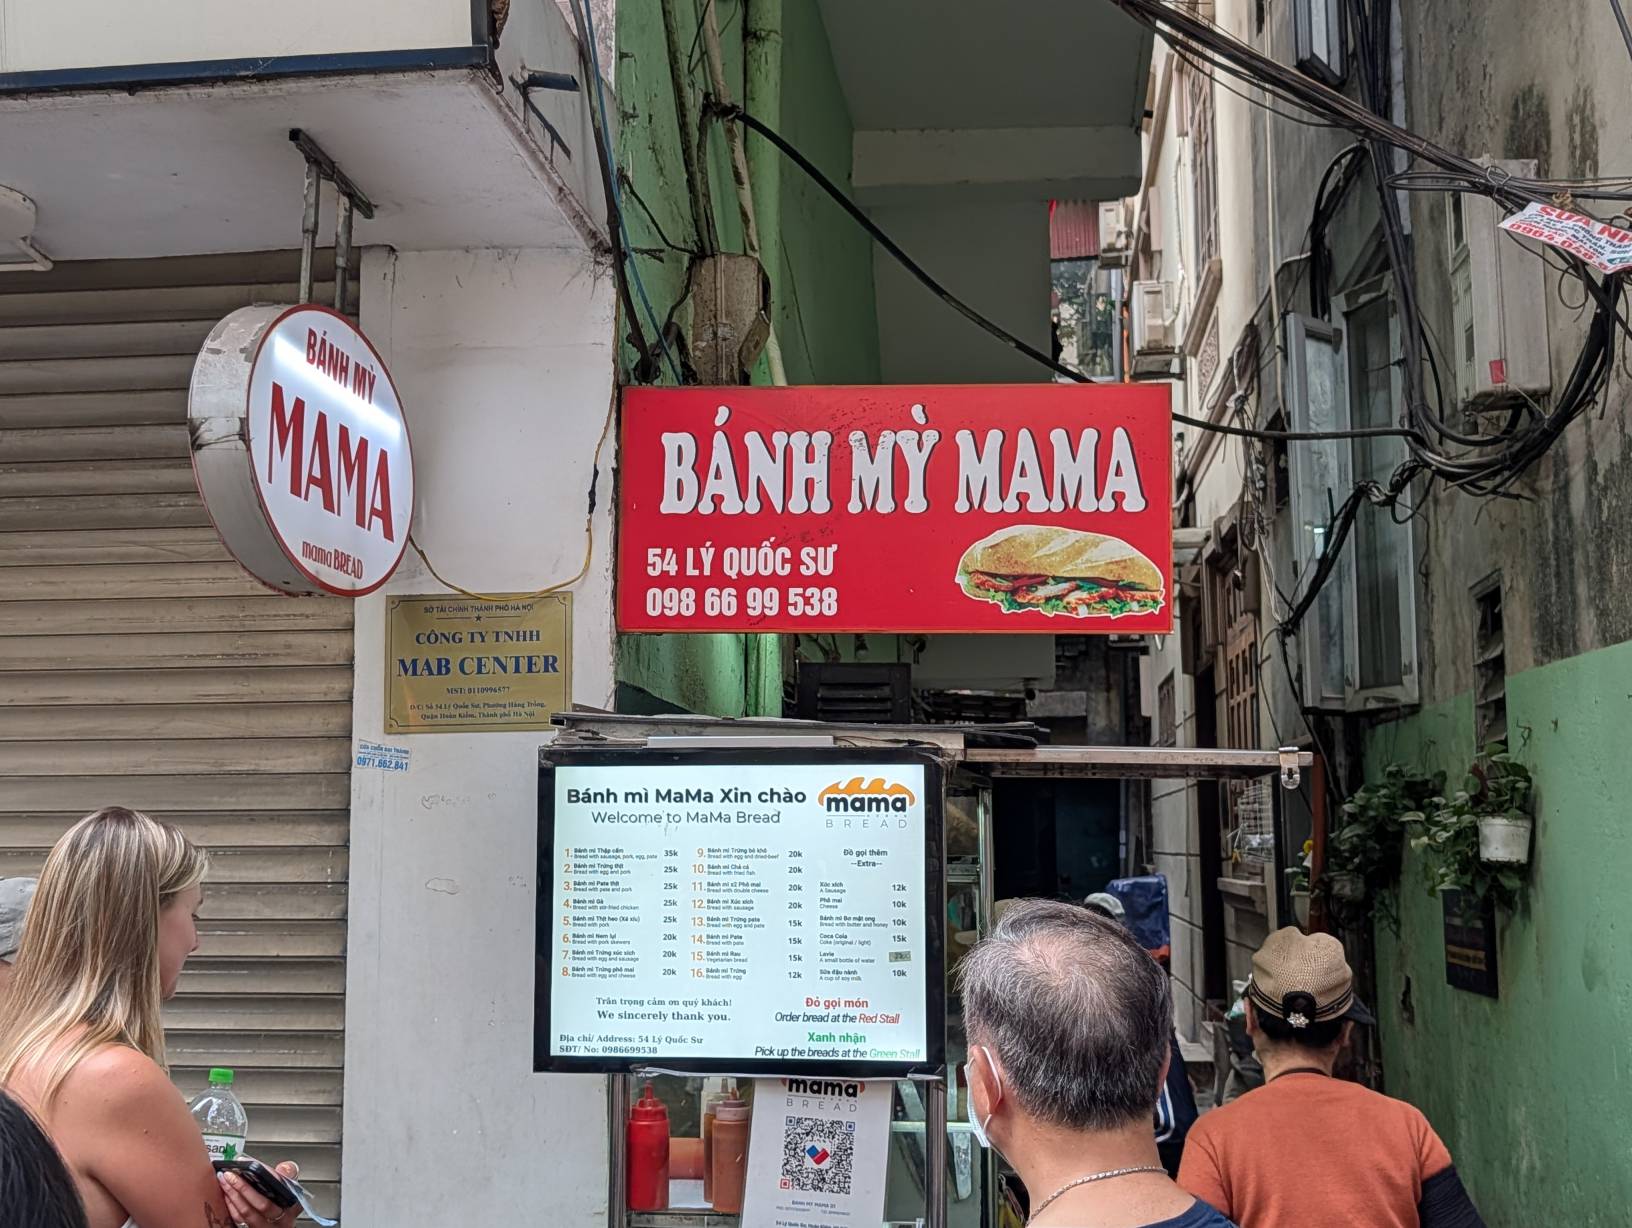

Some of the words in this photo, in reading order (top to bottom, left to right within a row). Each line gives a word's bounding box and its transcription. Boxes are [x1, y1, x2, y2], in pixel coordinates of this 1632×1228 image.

[306, 328, 350, 388] BÁNH
[353, 361, 377, 404] MỲ
[268, 381, 394, 543] MAMA
[660, 405, 834, 515] BÁNH
[848, 404, 941, 514] MỲ
[955, 427, 1147, 514] MAMA
[647, 547, 678, 576] 54
[686, 541, 714, 576] LÝ
[723, 536, 792, 576] QUỐC
[800, 543, 838, 576] SƯ
[646, 587, 696, 616] 098
[704, 587, 737, 616] 66
[746, 587, 779, 616] 99
[787, 587, 838, 616] 538
[416, 629, 462, 645] CÔNG
[467, 632, 488, 643] TY
[492, 630, 541, 643] TNHH
[397, 658, 451, 678] MAB
[459, 655, 560, 676] CENTER
[567, 787, 618, 803] Bánh
[624, 788, 648, 803] mì
[656, 789, 713, 803] MaMa
[720, 787, 752, 803] Xin
[758, 787, 807, 803] chào
[826, 796, 906, 812] mama
[592, 811, 662, 823] Welcome
[667, 813, 681, 823] to
[686, 811, 731, 823] MaMa
[736, 810, 781, 823] Bread
[856, 849, 867, 857] gọi
[805, 997, 820, 1008] Đỏ
[823, 998, 841, 1010] gọi
[844, 998, 868, 1008] món
[597, 1010, 614, 1019] We
[618, 1010, 668, 1021] sincerely
[671, 1011, 705, 1020] thank
[708, 1013, 731, 1022] you.
[775, 1012, 801, 1022] Order
[802, 1012, 829, 1023] bread
[831, 1014, 840, 1023] at
[842, 1013, 857, 1023] the
[859, 1014, 877, 1023] Red
[879, 1014, 901, 1024] Stall
[560, 1034, 575, 1043] Địa
[596, 1034, 635, 1043] Address:
[638, 1035, 649, 1043] 54
[652, 1035, 663, 1044] Lý
[665, 1035, 689, 1044] Quốc
[808, 1032, 836, 1043] Xanh
[839, 1032, 866, 1045] nhận
[755, 1046, 775, 1056] Pick
[777, 1049, 789, 1059] up
[791, 1047, 806, 1057] the
[807, 1047, 839, 1058] breads
[841, 1049, 850, 1058] at
[852, 1049, 867, 1058] the
[788, 1078, 858, 1098] mama
